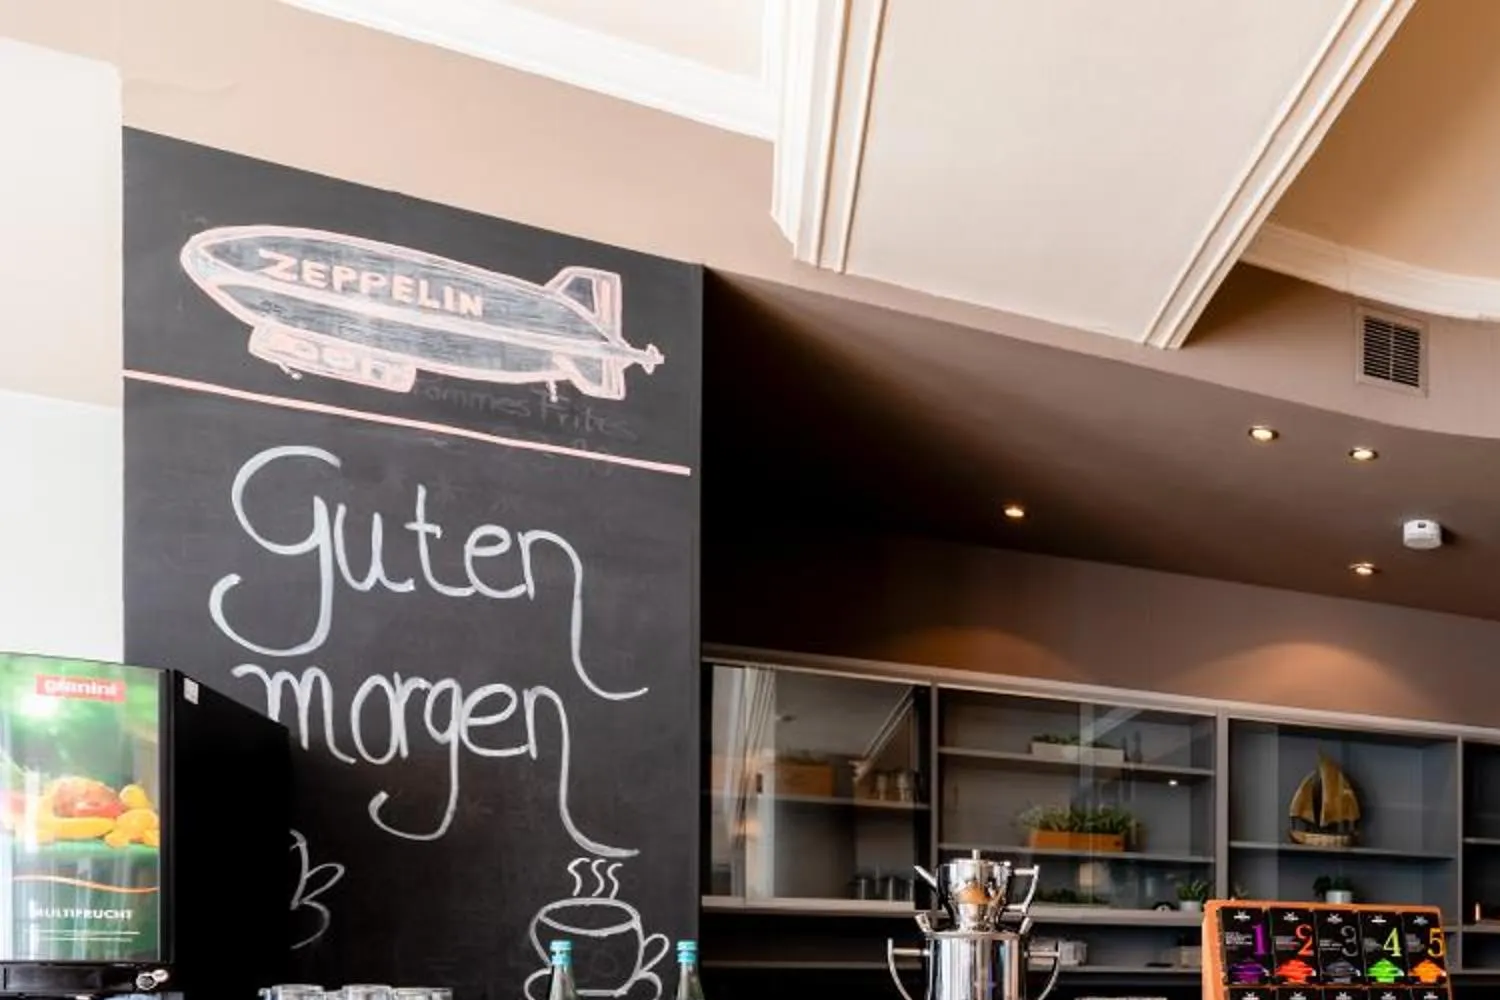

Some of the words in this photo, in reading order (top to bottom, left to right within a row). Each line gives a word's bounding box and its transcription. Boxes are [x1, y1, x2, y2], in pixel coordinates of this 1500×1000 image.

[257, 246, 484, 319] ZEPPELIN
[208, 445, 649, 699] Guten
[1252, 924, 1266, 955] 1
[1295, 924, 1314, 956] 2
[1341, 925, 1358, 957] 3
[1383, 928, 1401, 957] 4
[1427, 928, 1445, 957] 5
